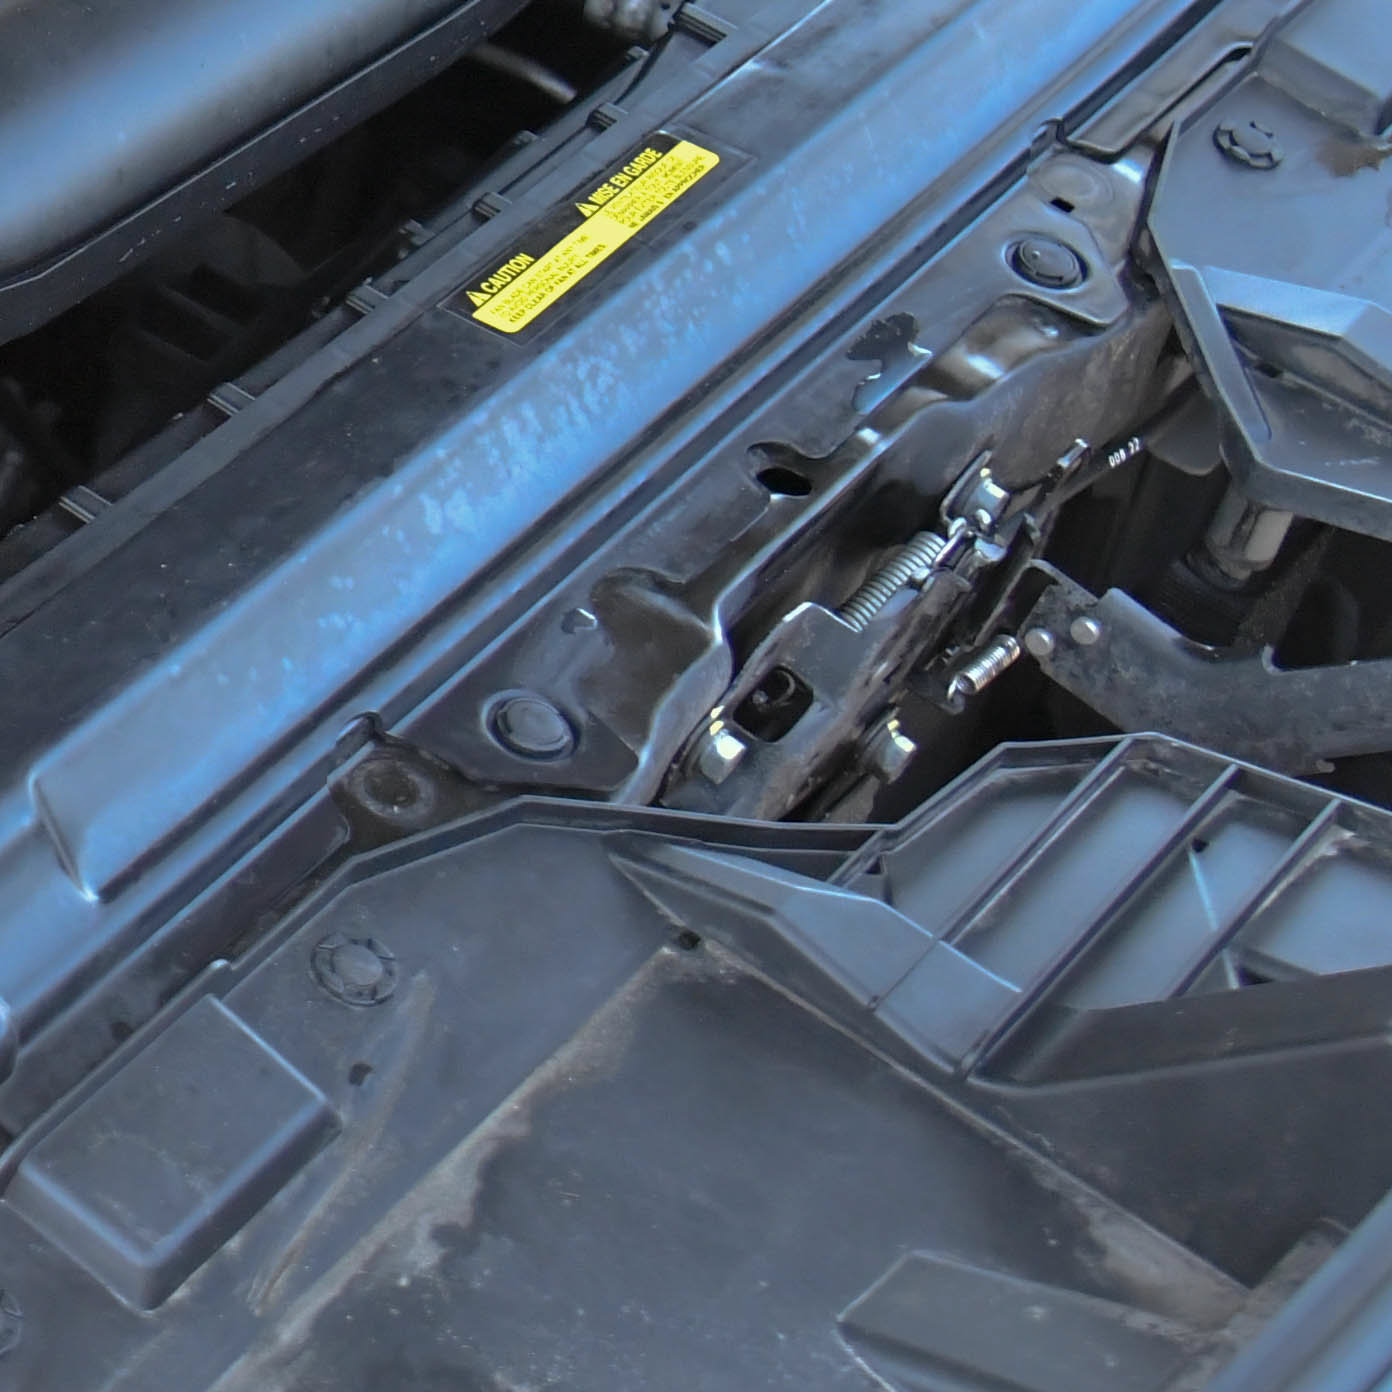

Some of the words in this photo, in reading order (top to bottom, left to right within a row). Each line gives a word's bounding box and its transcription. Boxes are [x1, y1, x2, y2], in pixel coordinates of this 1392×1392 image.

[588, 181, 618, 207] MISE
[612, 171, 633, 188] EN
[623, 147, 663, 177] GARDE
[480, 252, 535, 293] CAUTION
